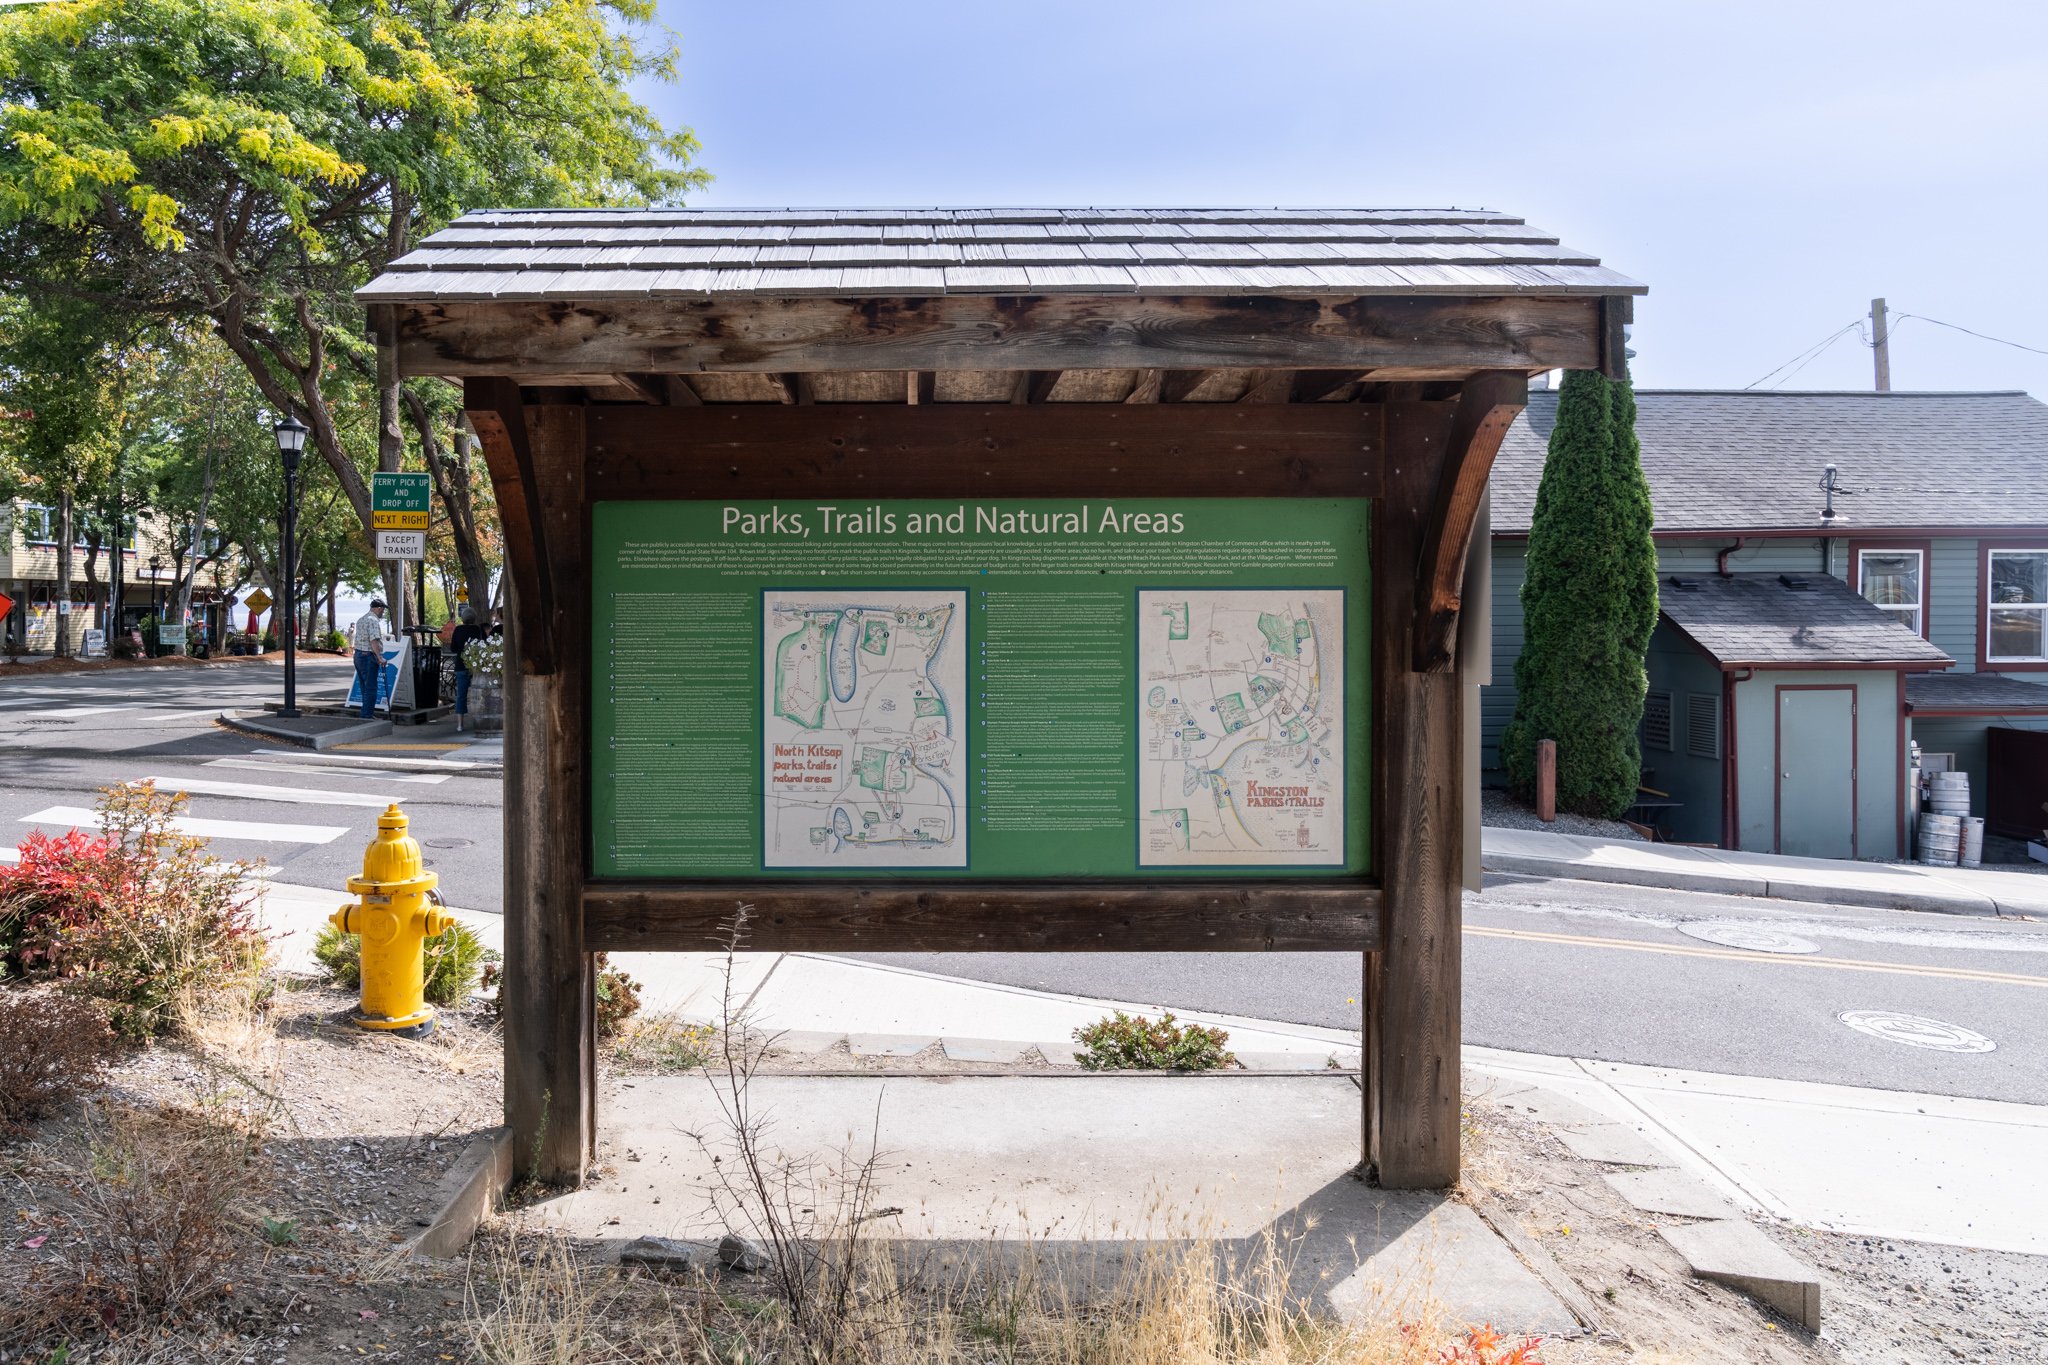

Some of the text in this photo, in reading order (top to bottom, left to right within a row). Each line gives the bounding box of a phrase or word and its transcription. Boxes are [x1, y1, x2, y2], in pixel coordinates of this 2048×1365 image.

[374, 478, 396, 486] FERRY
[374, 515, 427, 524] NEXT RIGHT
[722, 506, 1185, 537] Parks, Trails and Natural Areas
[775, 744, 842, 759] North Kitsap
[774, 759, 805, 771] parks,
[807, 759, 832, 770] trails
[773, 772, 803, 783] natural
[1247, 780, 1309, 797] KINGSTON
[1247, 798, 1284, 807] PARKS
[1288, 797, 1325, 807] TRAILS
